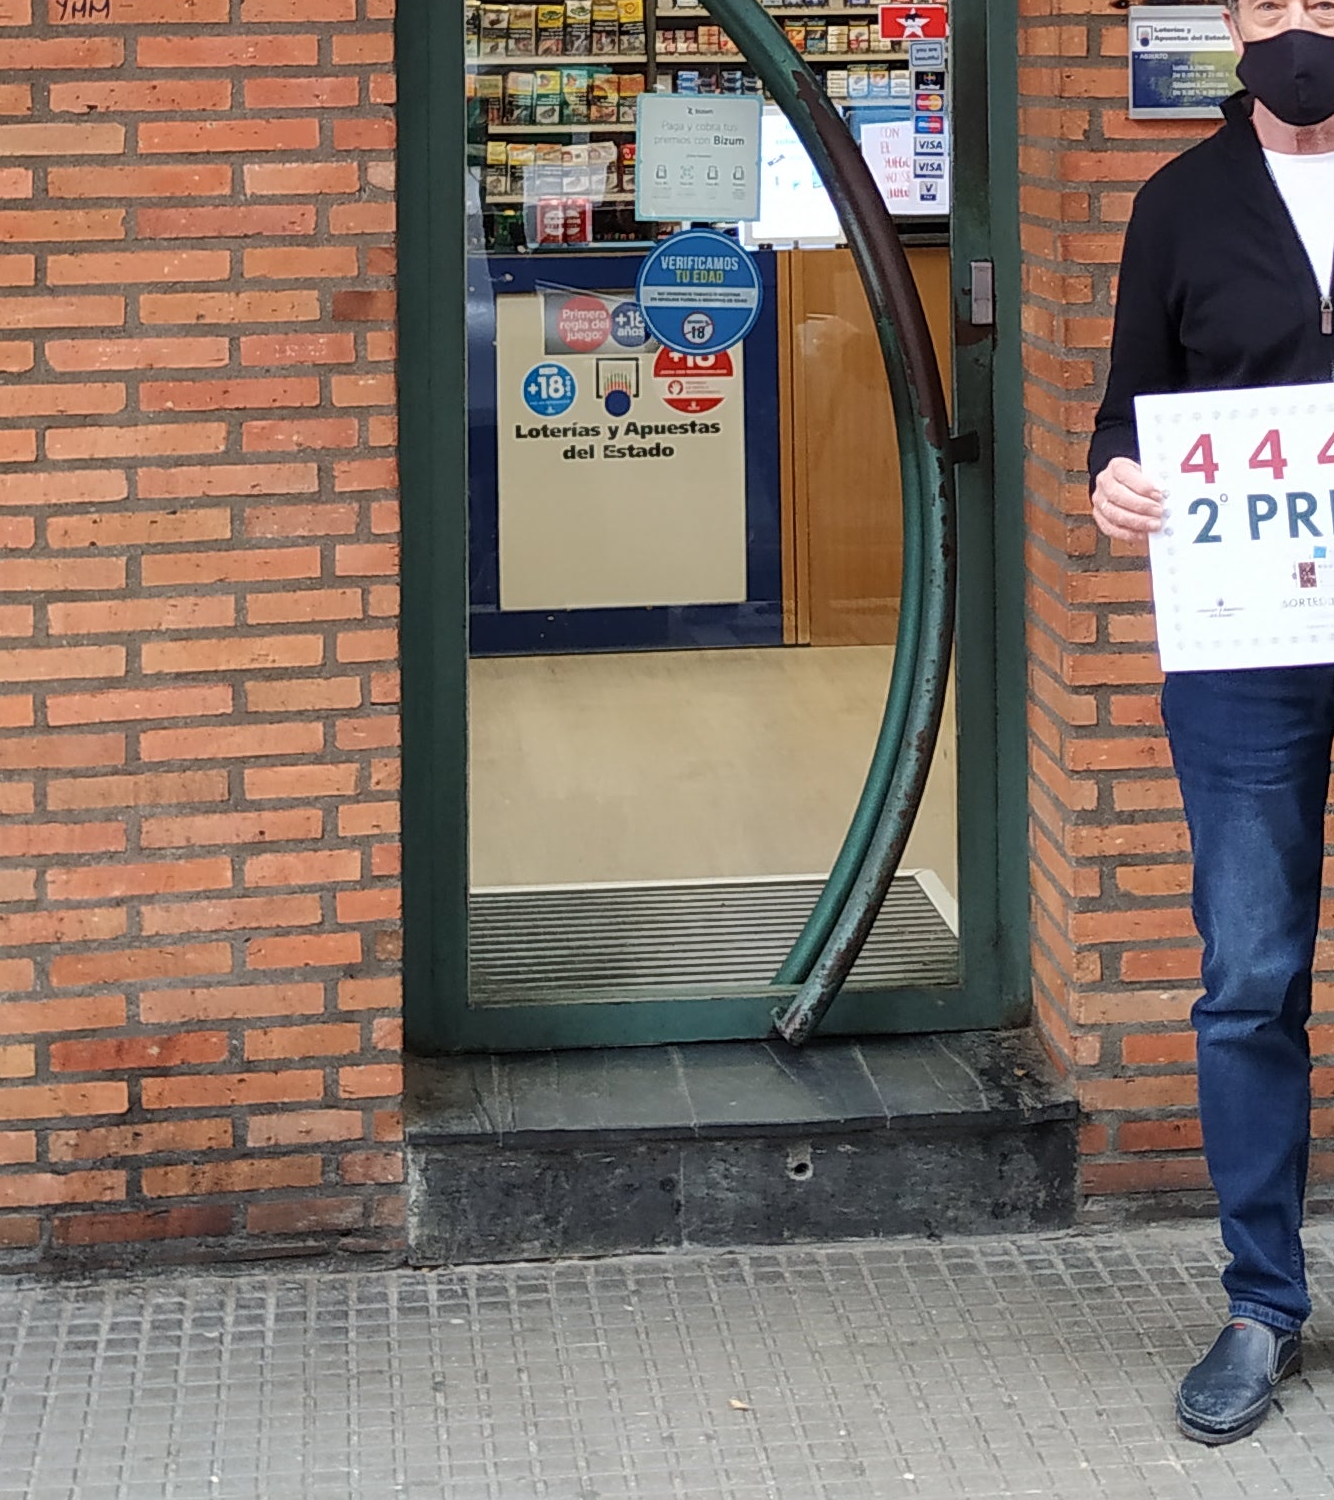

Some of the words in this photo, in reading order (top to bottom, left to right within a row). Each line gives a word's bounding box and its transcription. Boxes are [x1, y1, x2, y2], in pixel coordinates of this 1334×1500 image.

[695, 121, 721, 131] cobra
[654, 136, 692, 147] premios
[713, 135, 745, 146] Bizum
[918, 140, 943, 150] VISA
[918, 162, 943, 173] VISA
[660, 255, 739, 270] VERIFICAMOS
[675, 269, 689, 283] TU
[693, 270, 724, 284] EDAD
[562, 308, 607, 319] Primera
[559, 319, 588, 333] regla
[590, 318, 610, 329] del
[566, 330, 603, 342] juego:
[617, 327, 645, 337] años
[690, 326, 705, 339] 18
[527, 375, 565, 399] +18
[515, 422, 601, 439] Loterías
[607, 424, 619, 440] y
[624, 421, 721, 440] Apuestas
[563, 444, 595, 459] del
[603, 442, 675, 459] Estado
